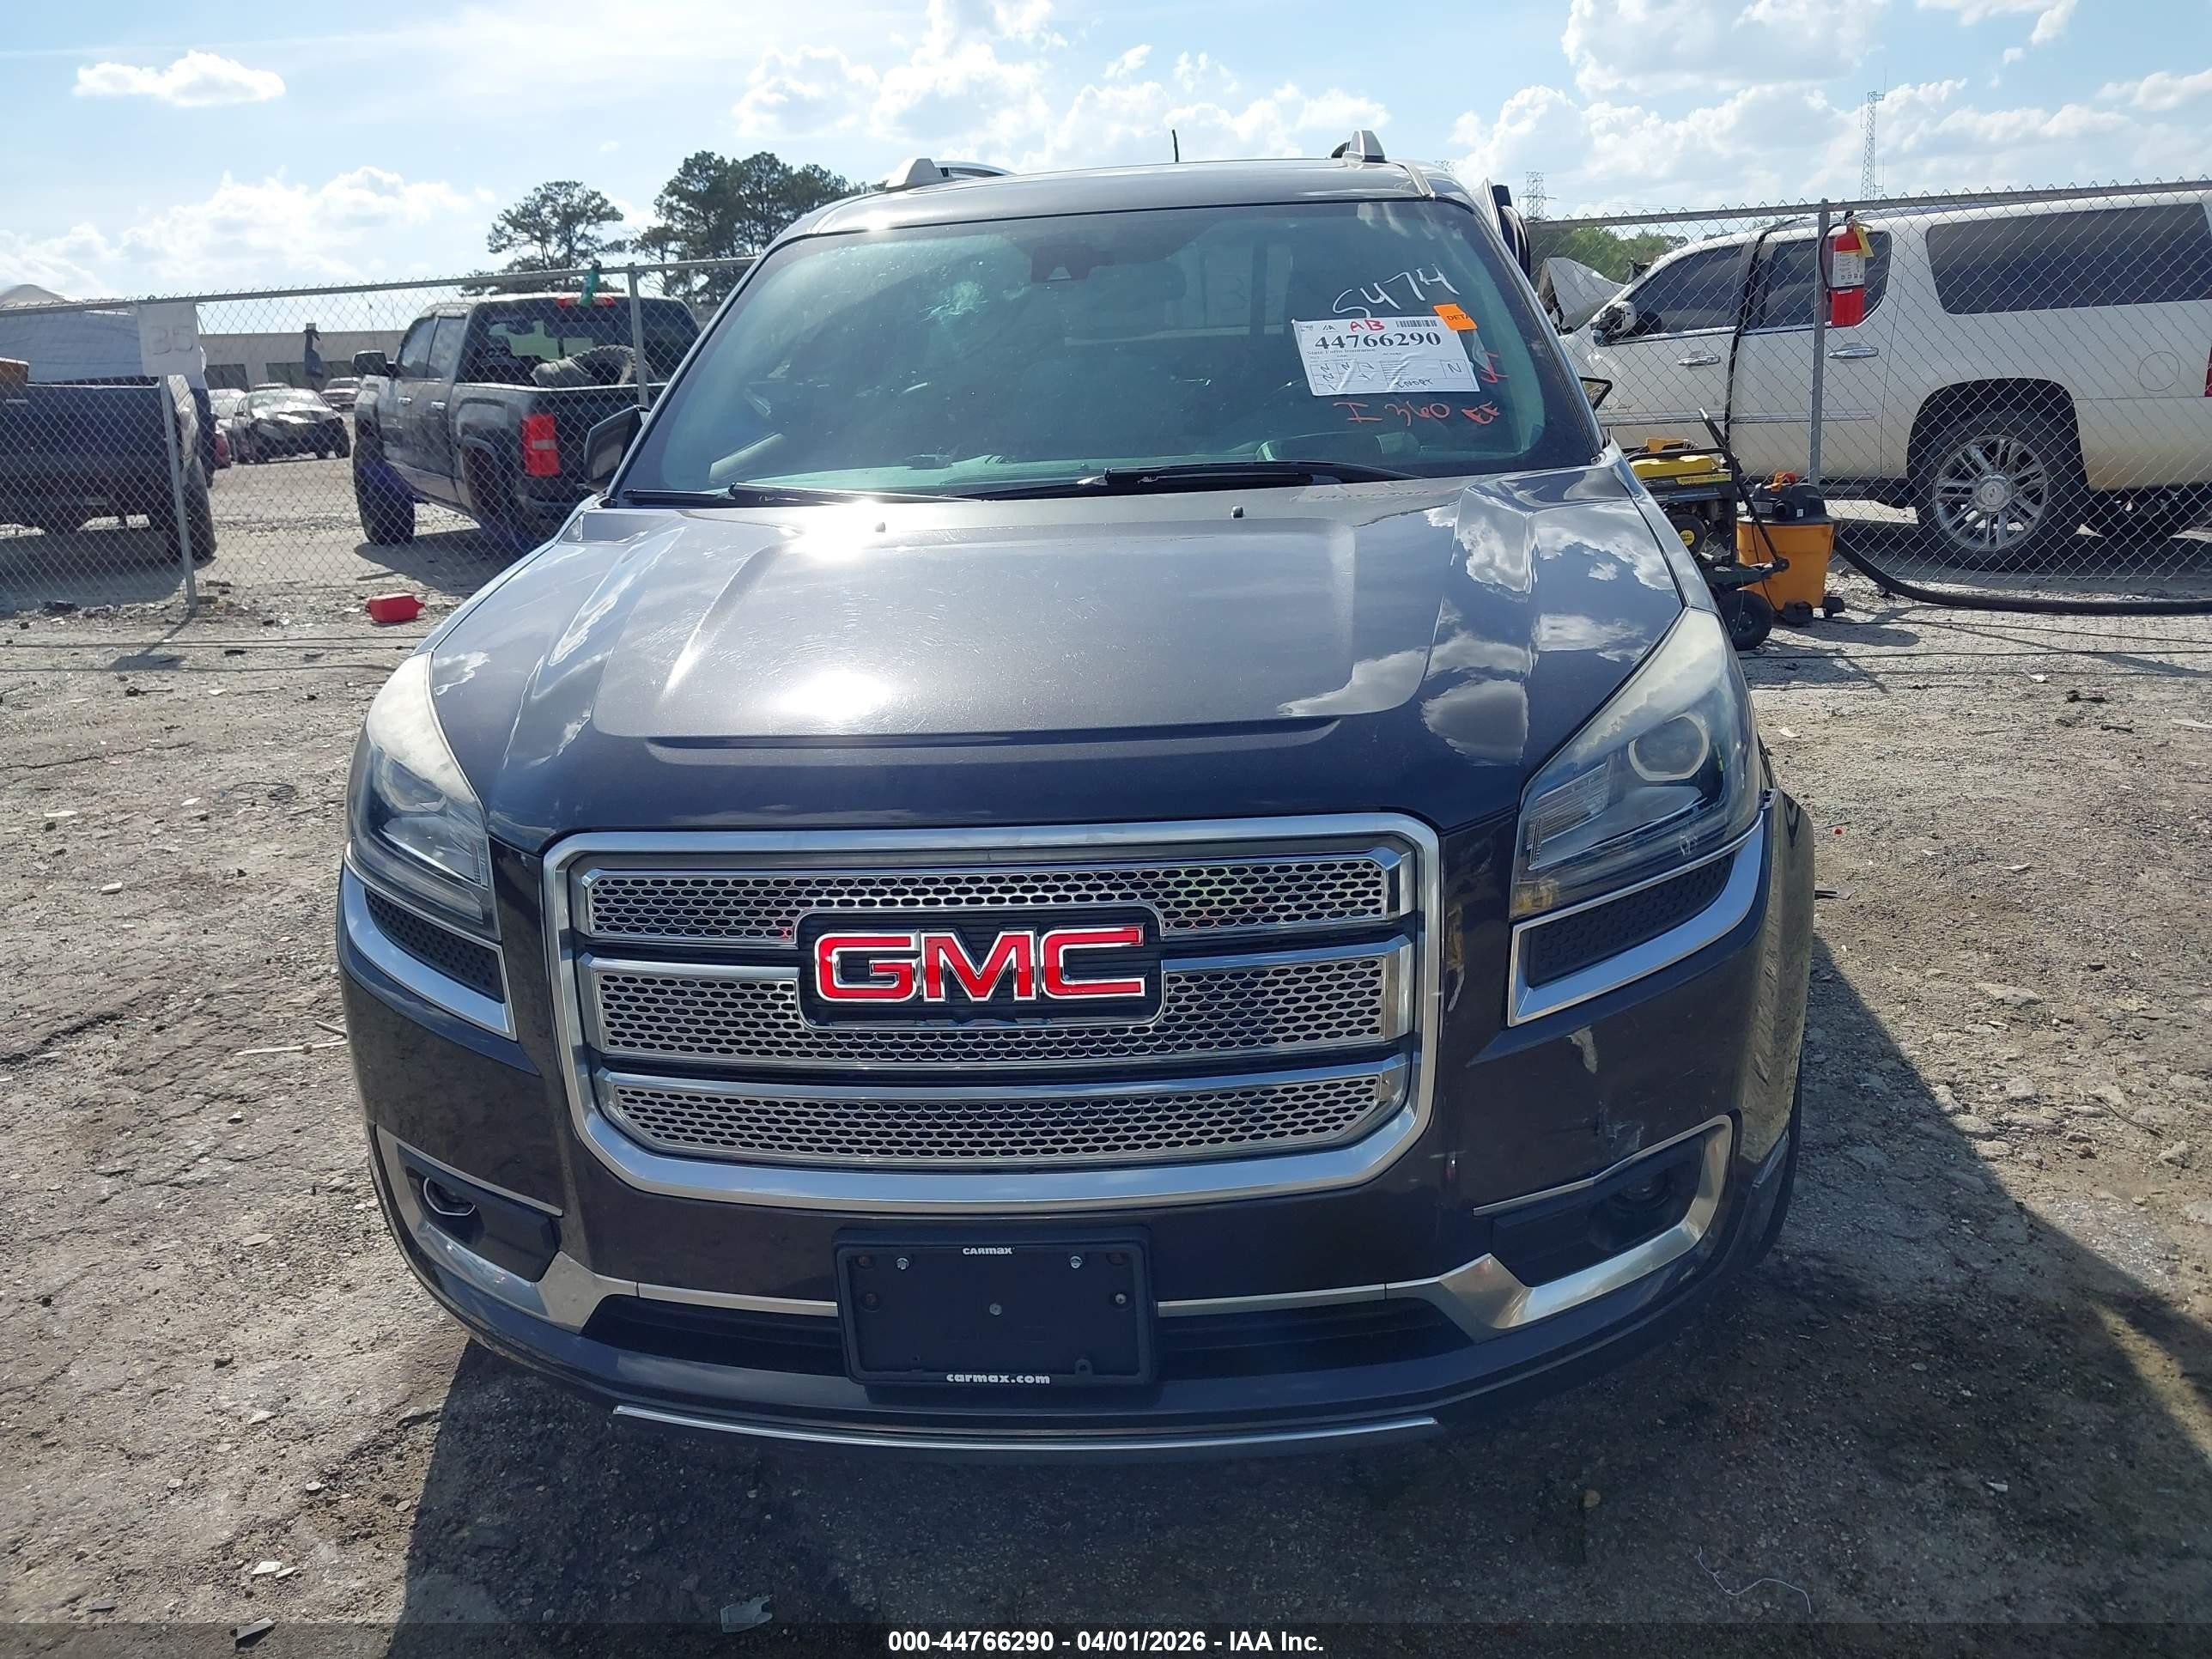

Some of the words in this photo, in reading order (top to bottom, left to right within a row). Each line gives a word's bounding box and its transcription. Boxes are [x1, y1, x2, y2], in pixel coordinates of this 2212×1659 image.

[1314, 331, 1442, 349] 44766290
[814, 925, 1146, 1002] GMC
[945, 1372, 1051, 1385] carmax.com
